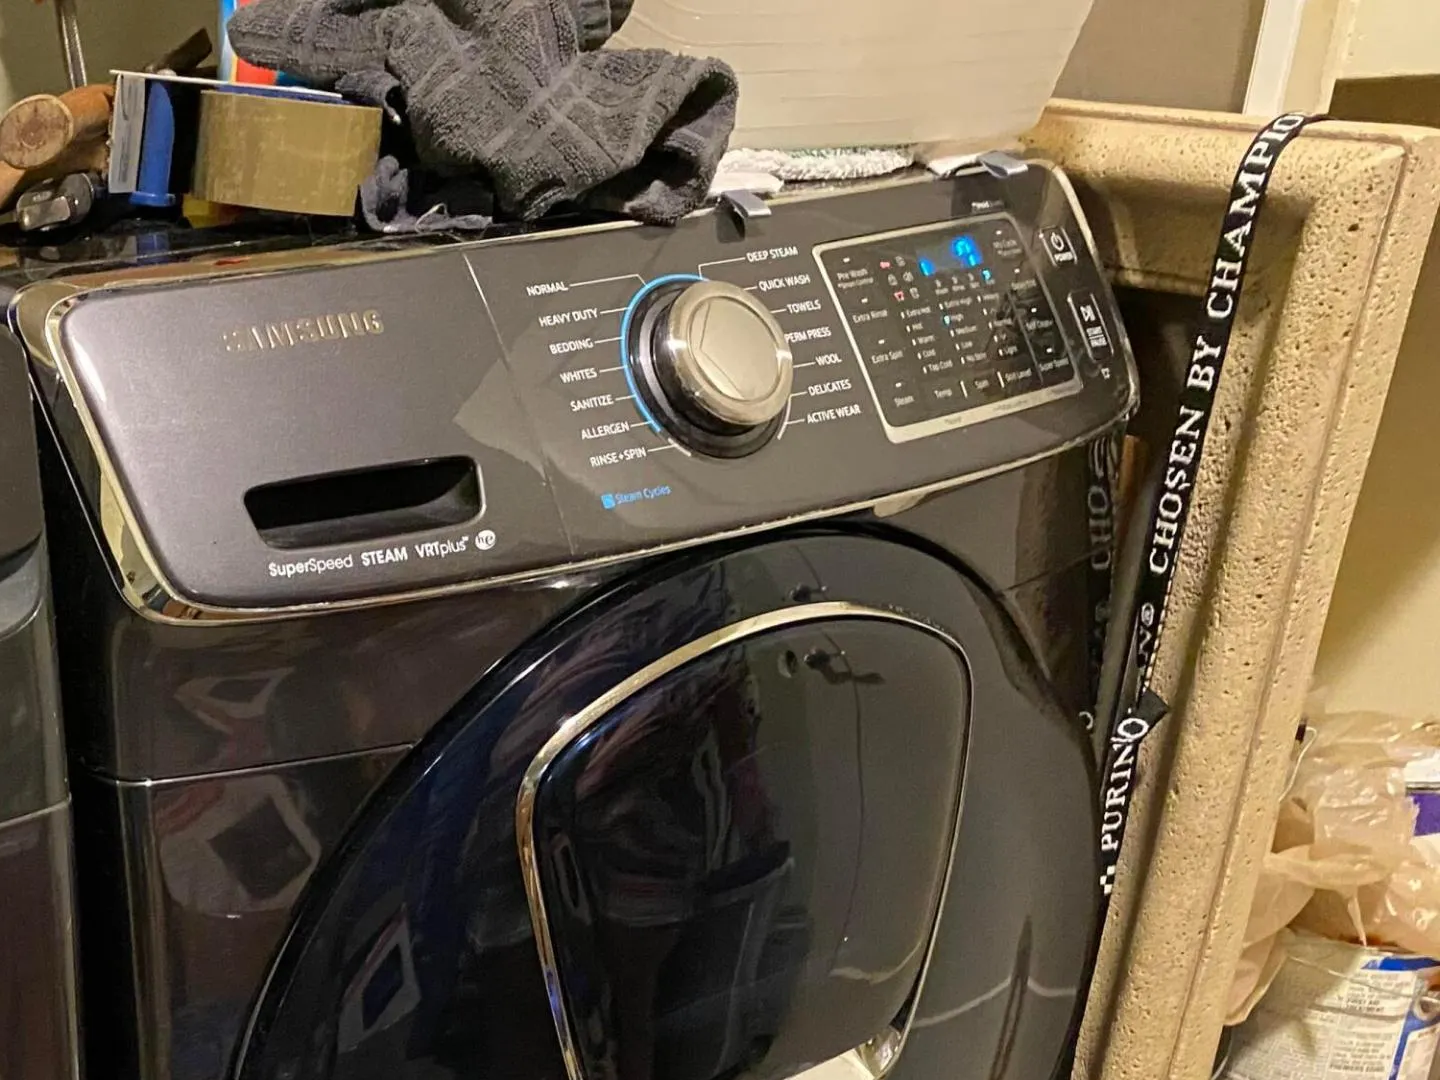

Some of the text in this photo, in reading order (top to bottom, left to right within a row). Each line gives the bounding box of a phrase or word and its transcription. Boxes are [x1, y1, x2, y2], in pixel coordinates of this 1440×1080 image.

[746, 246, 798, 262] DEEP STEAM
[526, 281, 569, 296] NORMAL
[759, 273, 810, 292] QUICK WASH
[787, 299, 821, 314] TOWELS
[538, 308, 598, 327] HEAVY DUTY
[222, 309, 384, 351] SAMSUNG
[784, 326, 832, 344] PERM PRESS
[549, 338, 594, 355] BEDDING
[815, 353, 842, 366] WOOL
[560, 367, 598, 383] WHITES
[808, 379, 852, 397] DELICATES
[570, 394, 614, 412] SANITIZE
[807, 403, 861, 424] ACTIVE WEAR
[581, 421, 630, 440] ALLERGEN
[1101, 739, 1135, 851] PURIN
[1149, 405, 1204, 574] CHOSEN
[1187, 335, 1222, 392] BY
[1206, 112, 1305, 320] CHAMPIO
[643, 485, 672, 499] Cycles
[268, 554, 353, 579] SuperSpeed
[360, 546, 408, 567] STEAM
